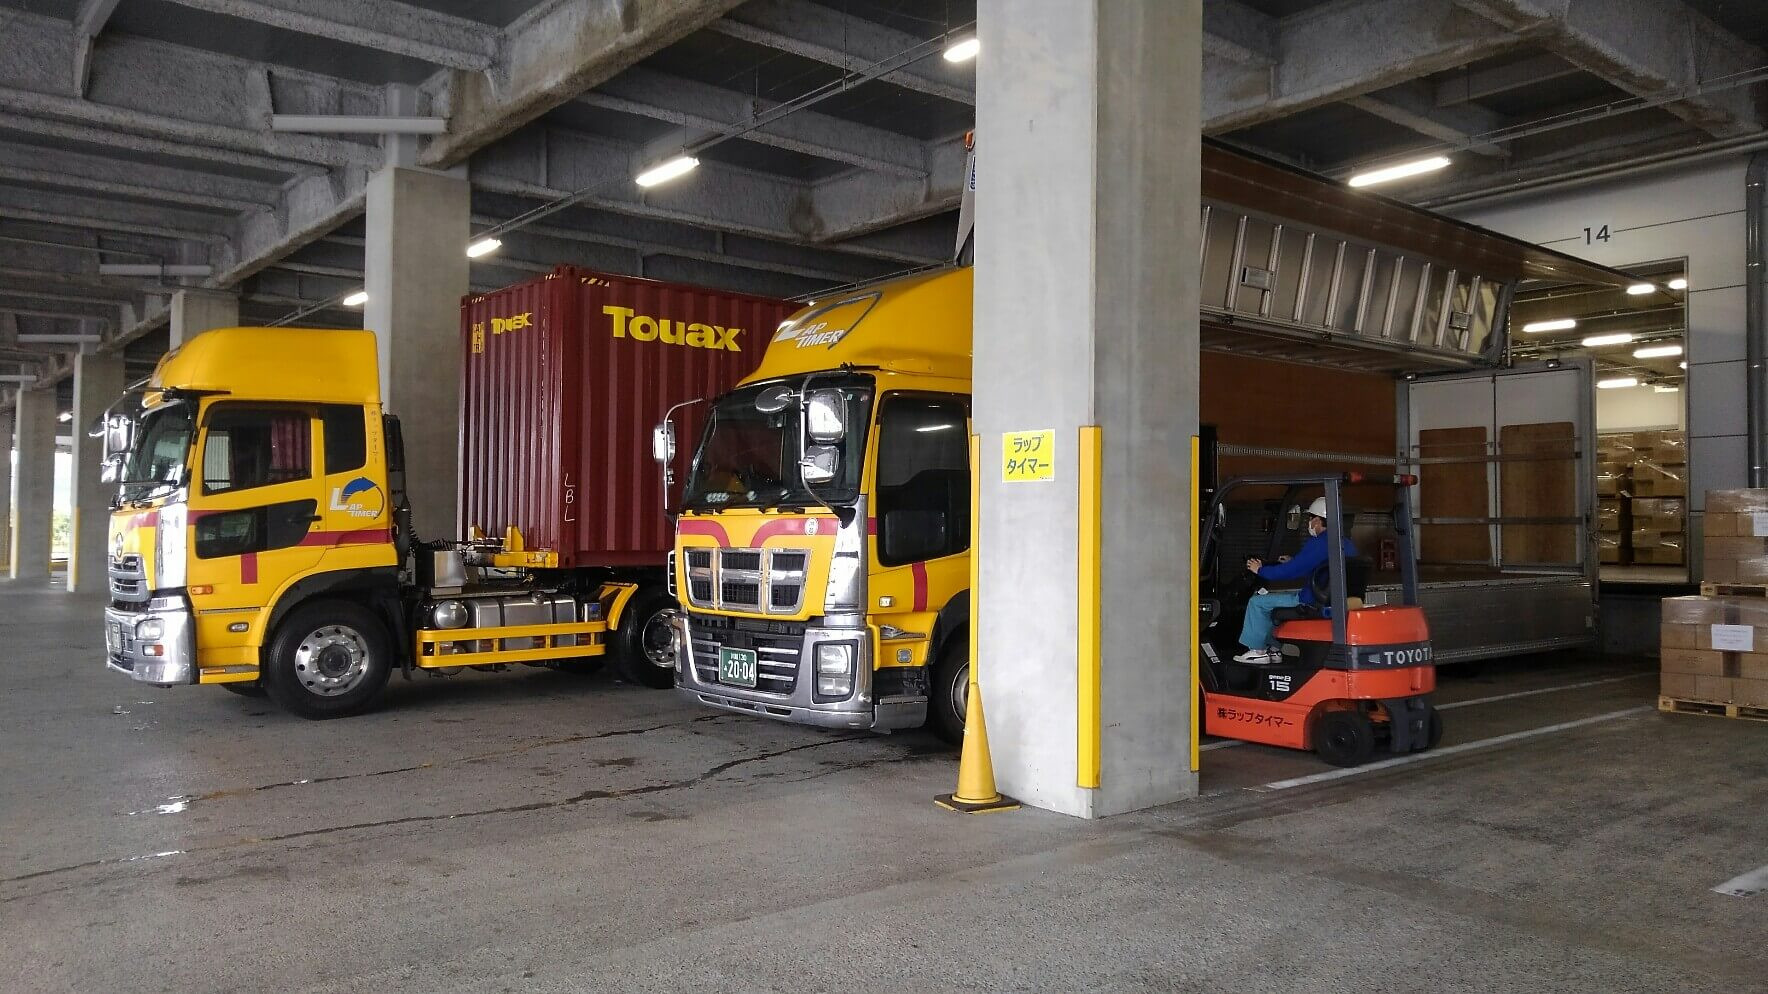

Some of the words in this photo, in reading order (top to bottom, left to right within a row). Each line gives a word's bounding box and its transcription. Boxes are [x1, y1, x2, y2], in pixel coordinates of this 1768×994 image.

[1584, 225, 1611, 246] 14
[603, 305, 742, 352] Touax
[795, 330, 845, 349] TIMER
[1013, 434, 1044, 453] ラップ
[1006, 458, 1049, 475] タイマー
[346, 510, 379, 518] TIMER
[1269, 680, 1290, 692] 15
